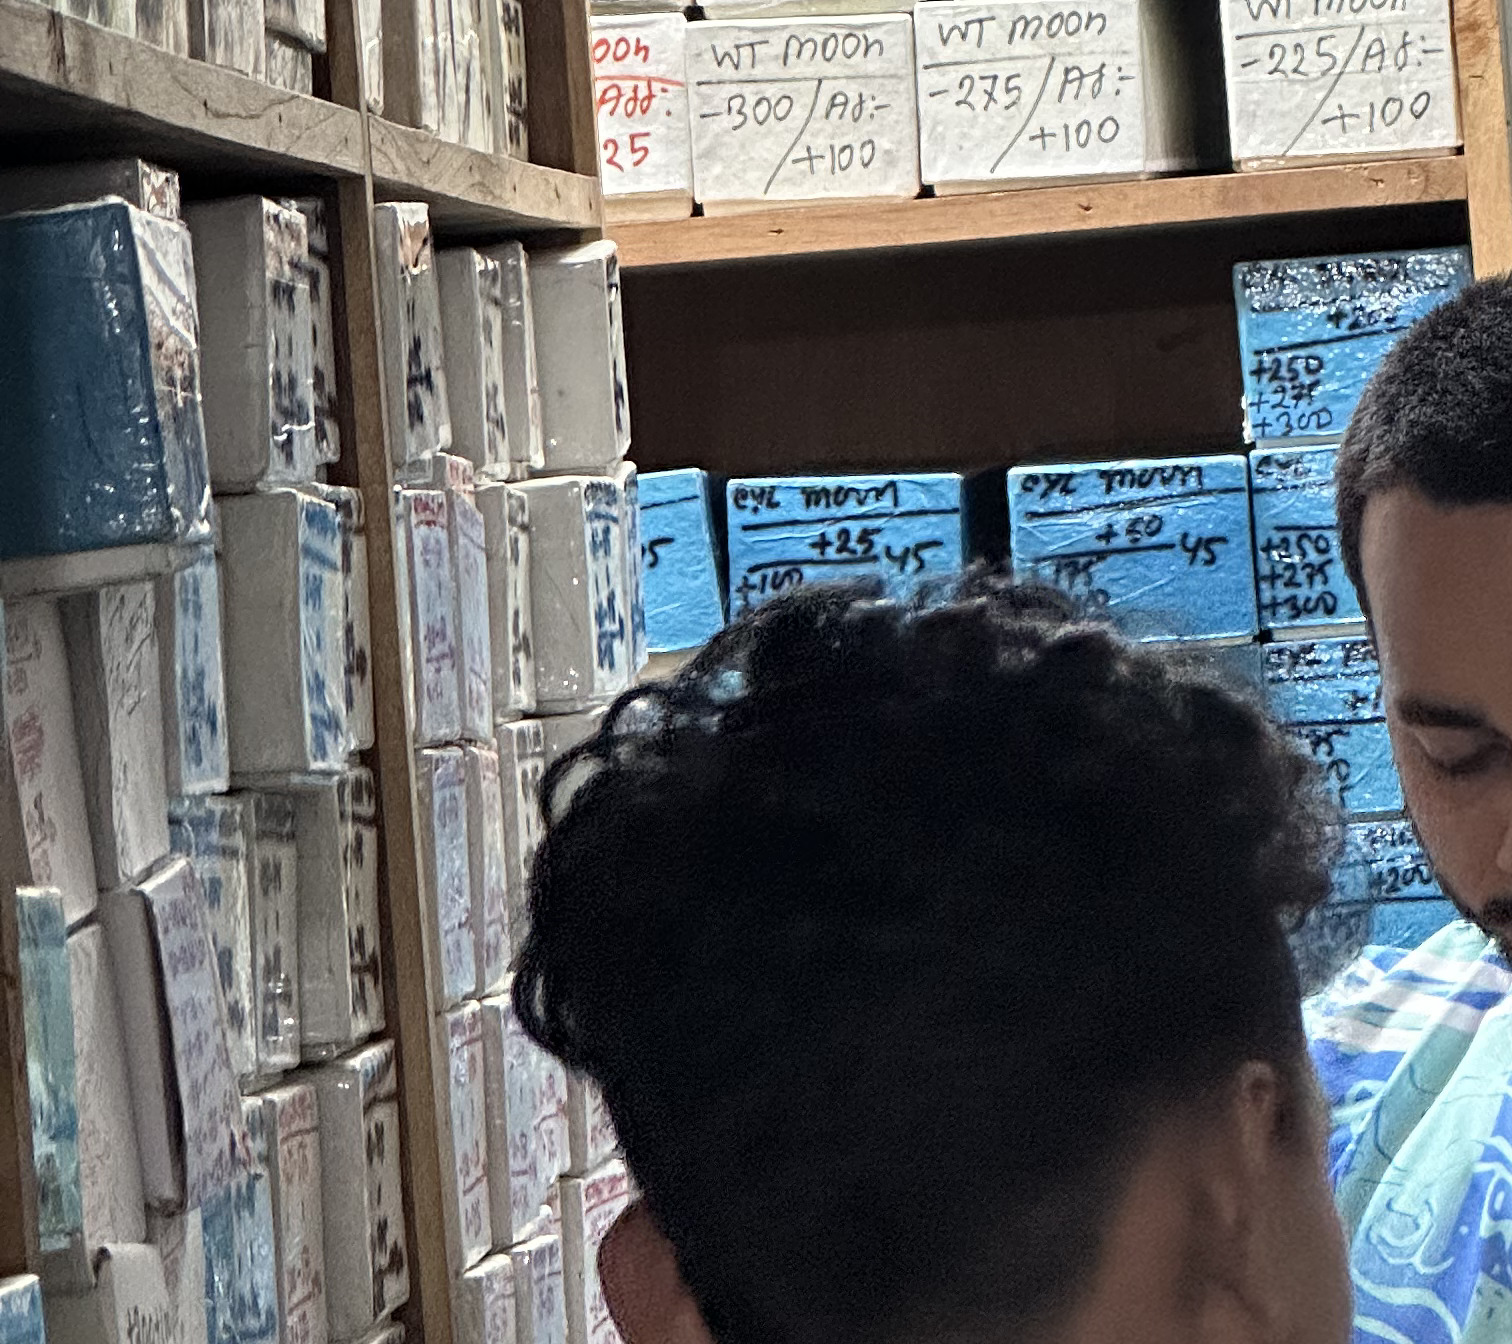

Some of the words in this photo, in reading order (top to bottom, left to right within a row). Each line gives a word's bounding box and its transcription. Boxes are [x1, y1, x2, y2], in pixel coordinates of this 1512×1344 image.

[938, 17, 995, 48] WT
[710, 40, 769, 71] WT
[1322, 92, 1431, 134] +100
[1028, 116, 1120, 151] +100
[792, 138, 876, 175] +100
[1250, 355, 1324, 384] +250
[808, 527, 884, 556] +25
